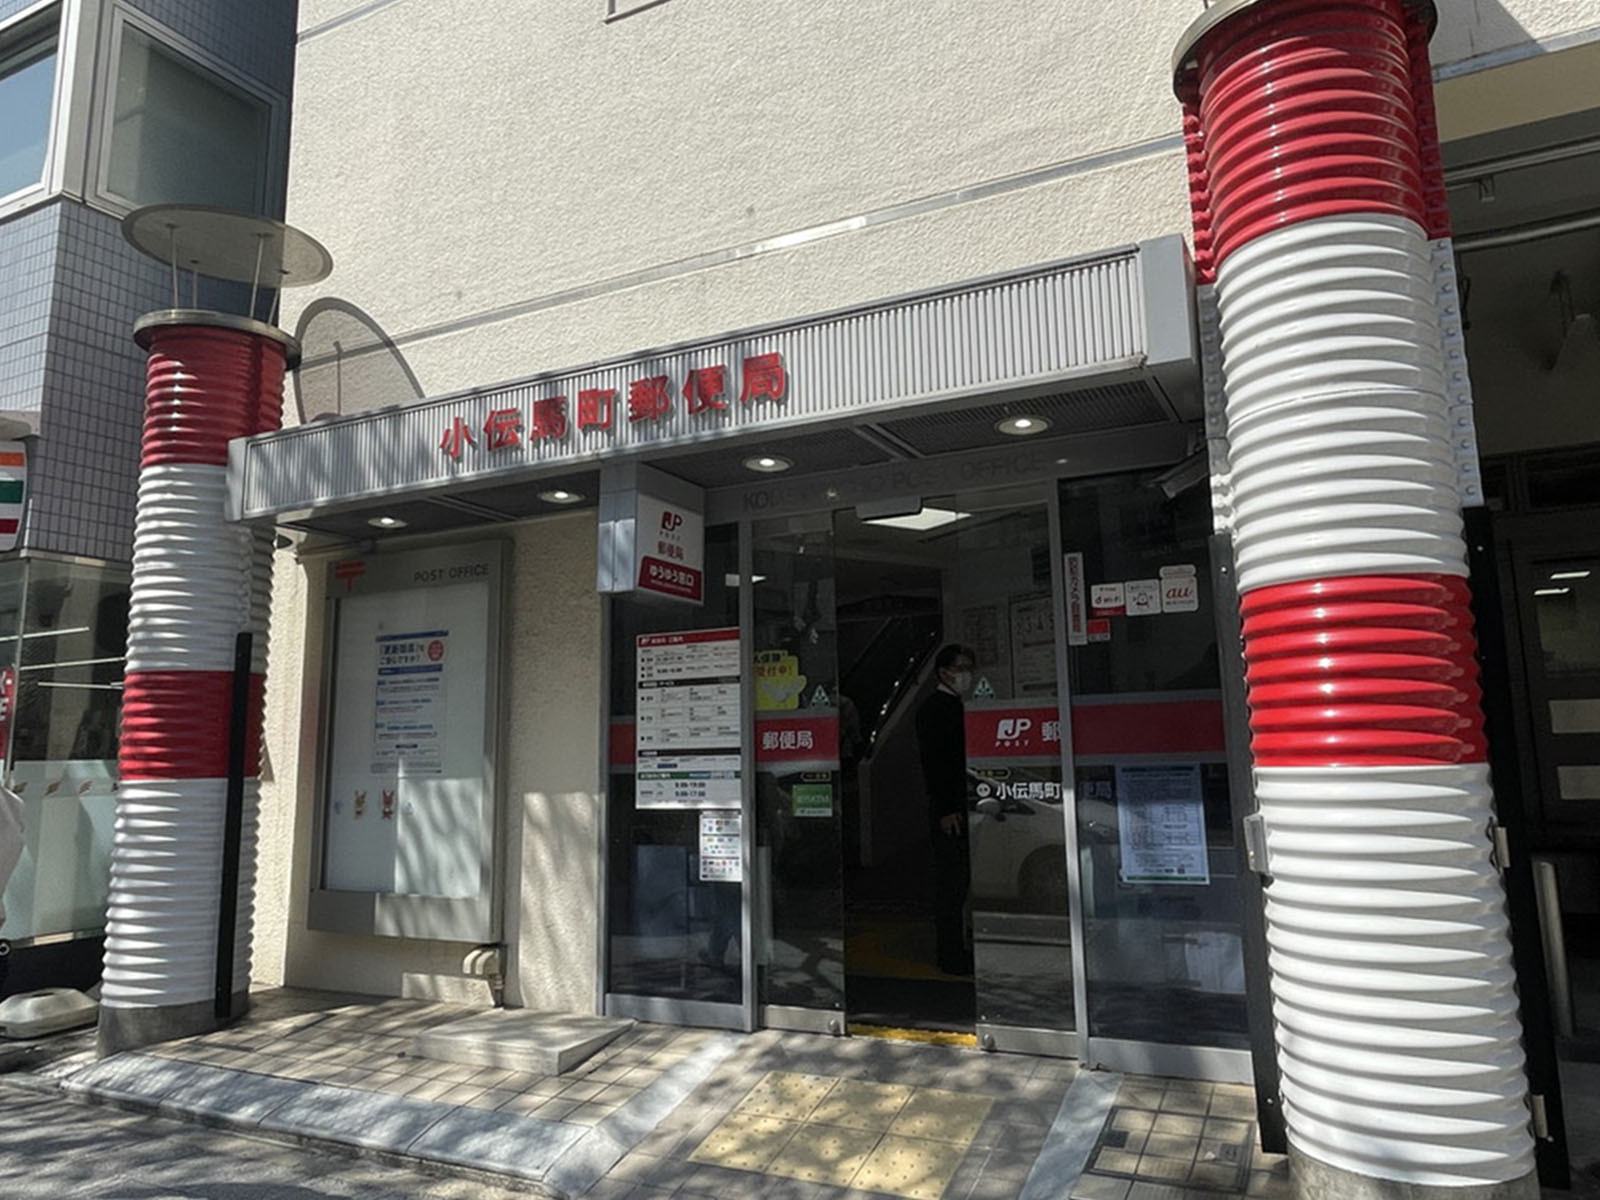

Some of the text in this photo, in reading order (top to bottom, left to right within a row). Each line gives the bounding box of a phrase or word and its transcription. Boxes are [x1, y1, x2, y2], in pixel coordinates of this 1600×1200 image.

[440, 353, 789, 459] 小伝馬町郵便局
[662, 511, 683, 531] JP
[414, 563, 489, 583] POST OFFICE
[649, 565, 694, 587] ゆうゆう窓口
[1166, 587, 1190, 600] au
[997, 718, 1032, 740] JP
[762, 730, 813, 750] 郵便局
[995, 739, 1030, 748] POST
[996, 782, 1061, 800] 小伝馬町
